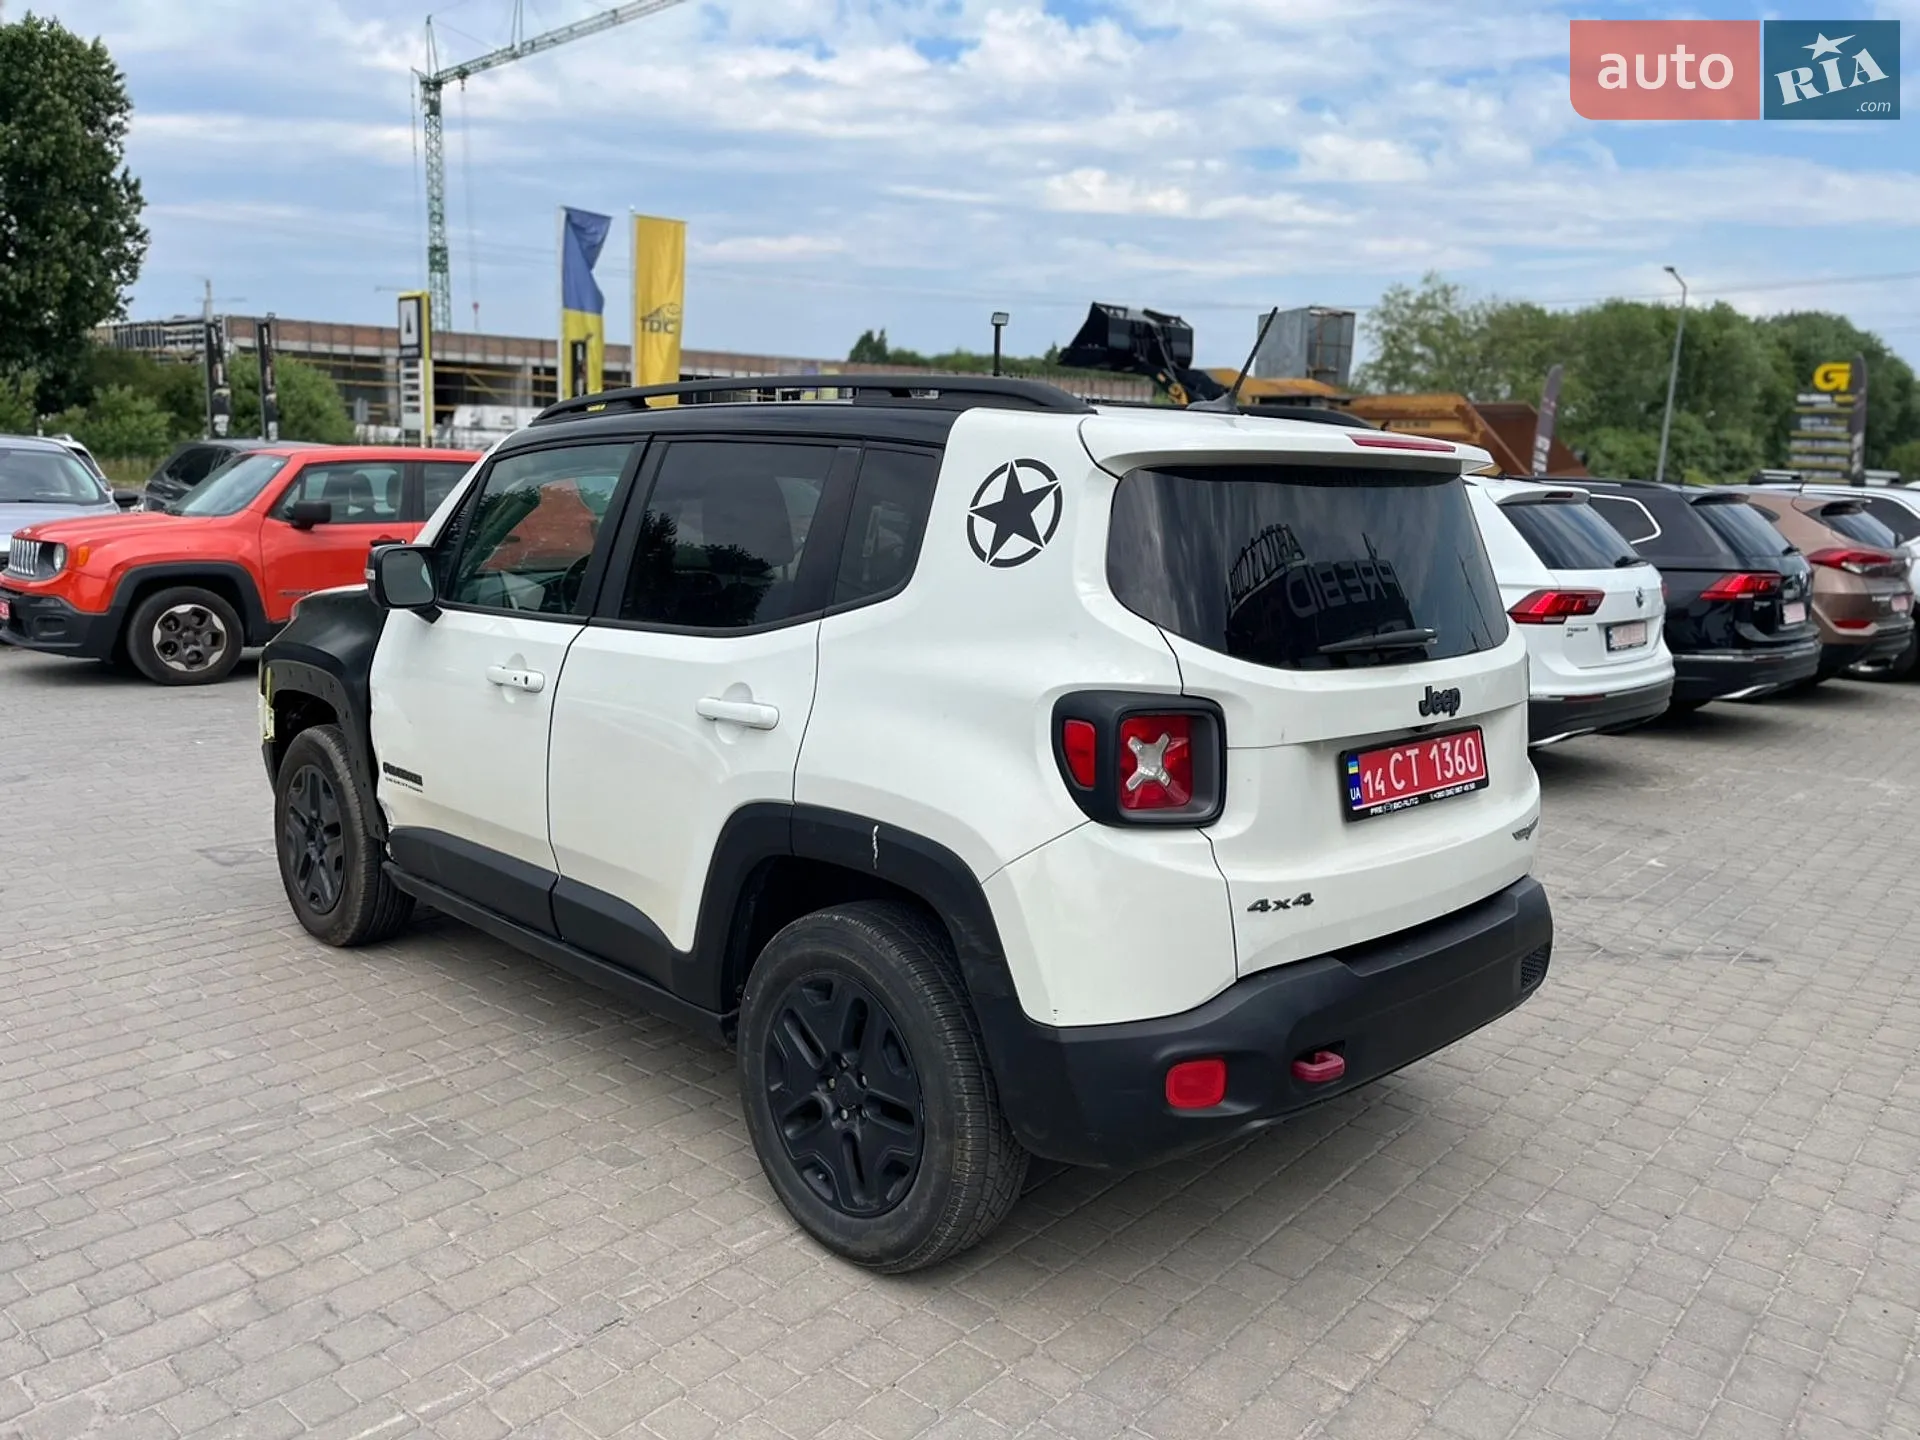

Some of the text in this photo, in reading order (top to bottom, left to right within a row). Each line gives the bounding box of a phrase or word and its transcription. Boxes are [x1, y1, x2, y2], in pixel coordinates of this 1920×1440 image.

[1418, 685, 1460, 717] Jeep
[1363, 767, 1386, 799] 14
[1389, 748, 1420, 791] CT
[1429, 737, 1478, 781] 1360
[1350, 786, 1362, 801] UA
